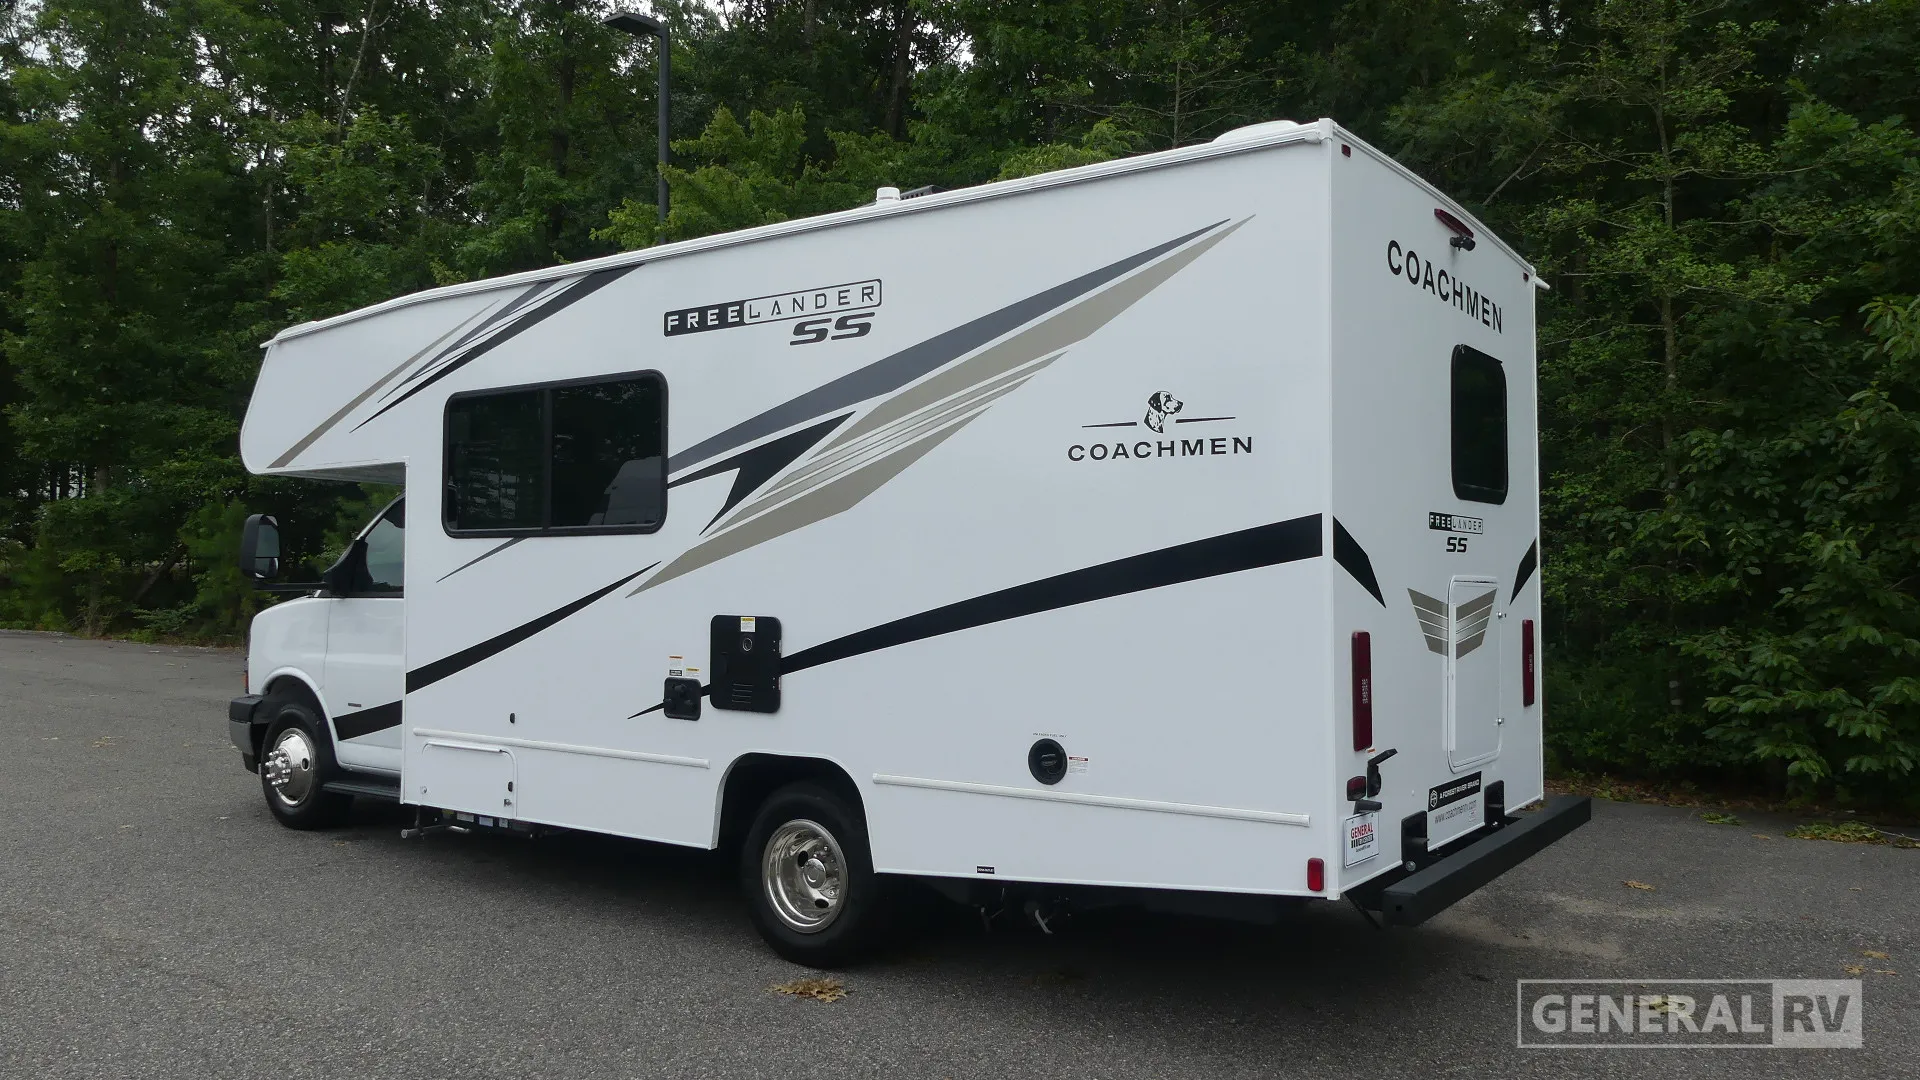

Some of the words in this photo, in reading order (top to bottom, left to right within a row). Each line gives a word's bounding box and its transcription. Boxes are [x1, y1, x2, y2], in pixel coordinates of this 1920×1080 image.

[1388, 240, 1502, 334] COACHMEN
[667, 286, 875, 332] FREELANDER
[790, 312, 875, 345] SS
[1068, 436, 1252, 462] COACHMEN
[1430, 515, 1482, 532] FREELANDER
[1446, 537, 1468, 552] SS
[1443, 787, 1456, 799] FOREST
[1351, 822, 1373, 839] GENERAL
